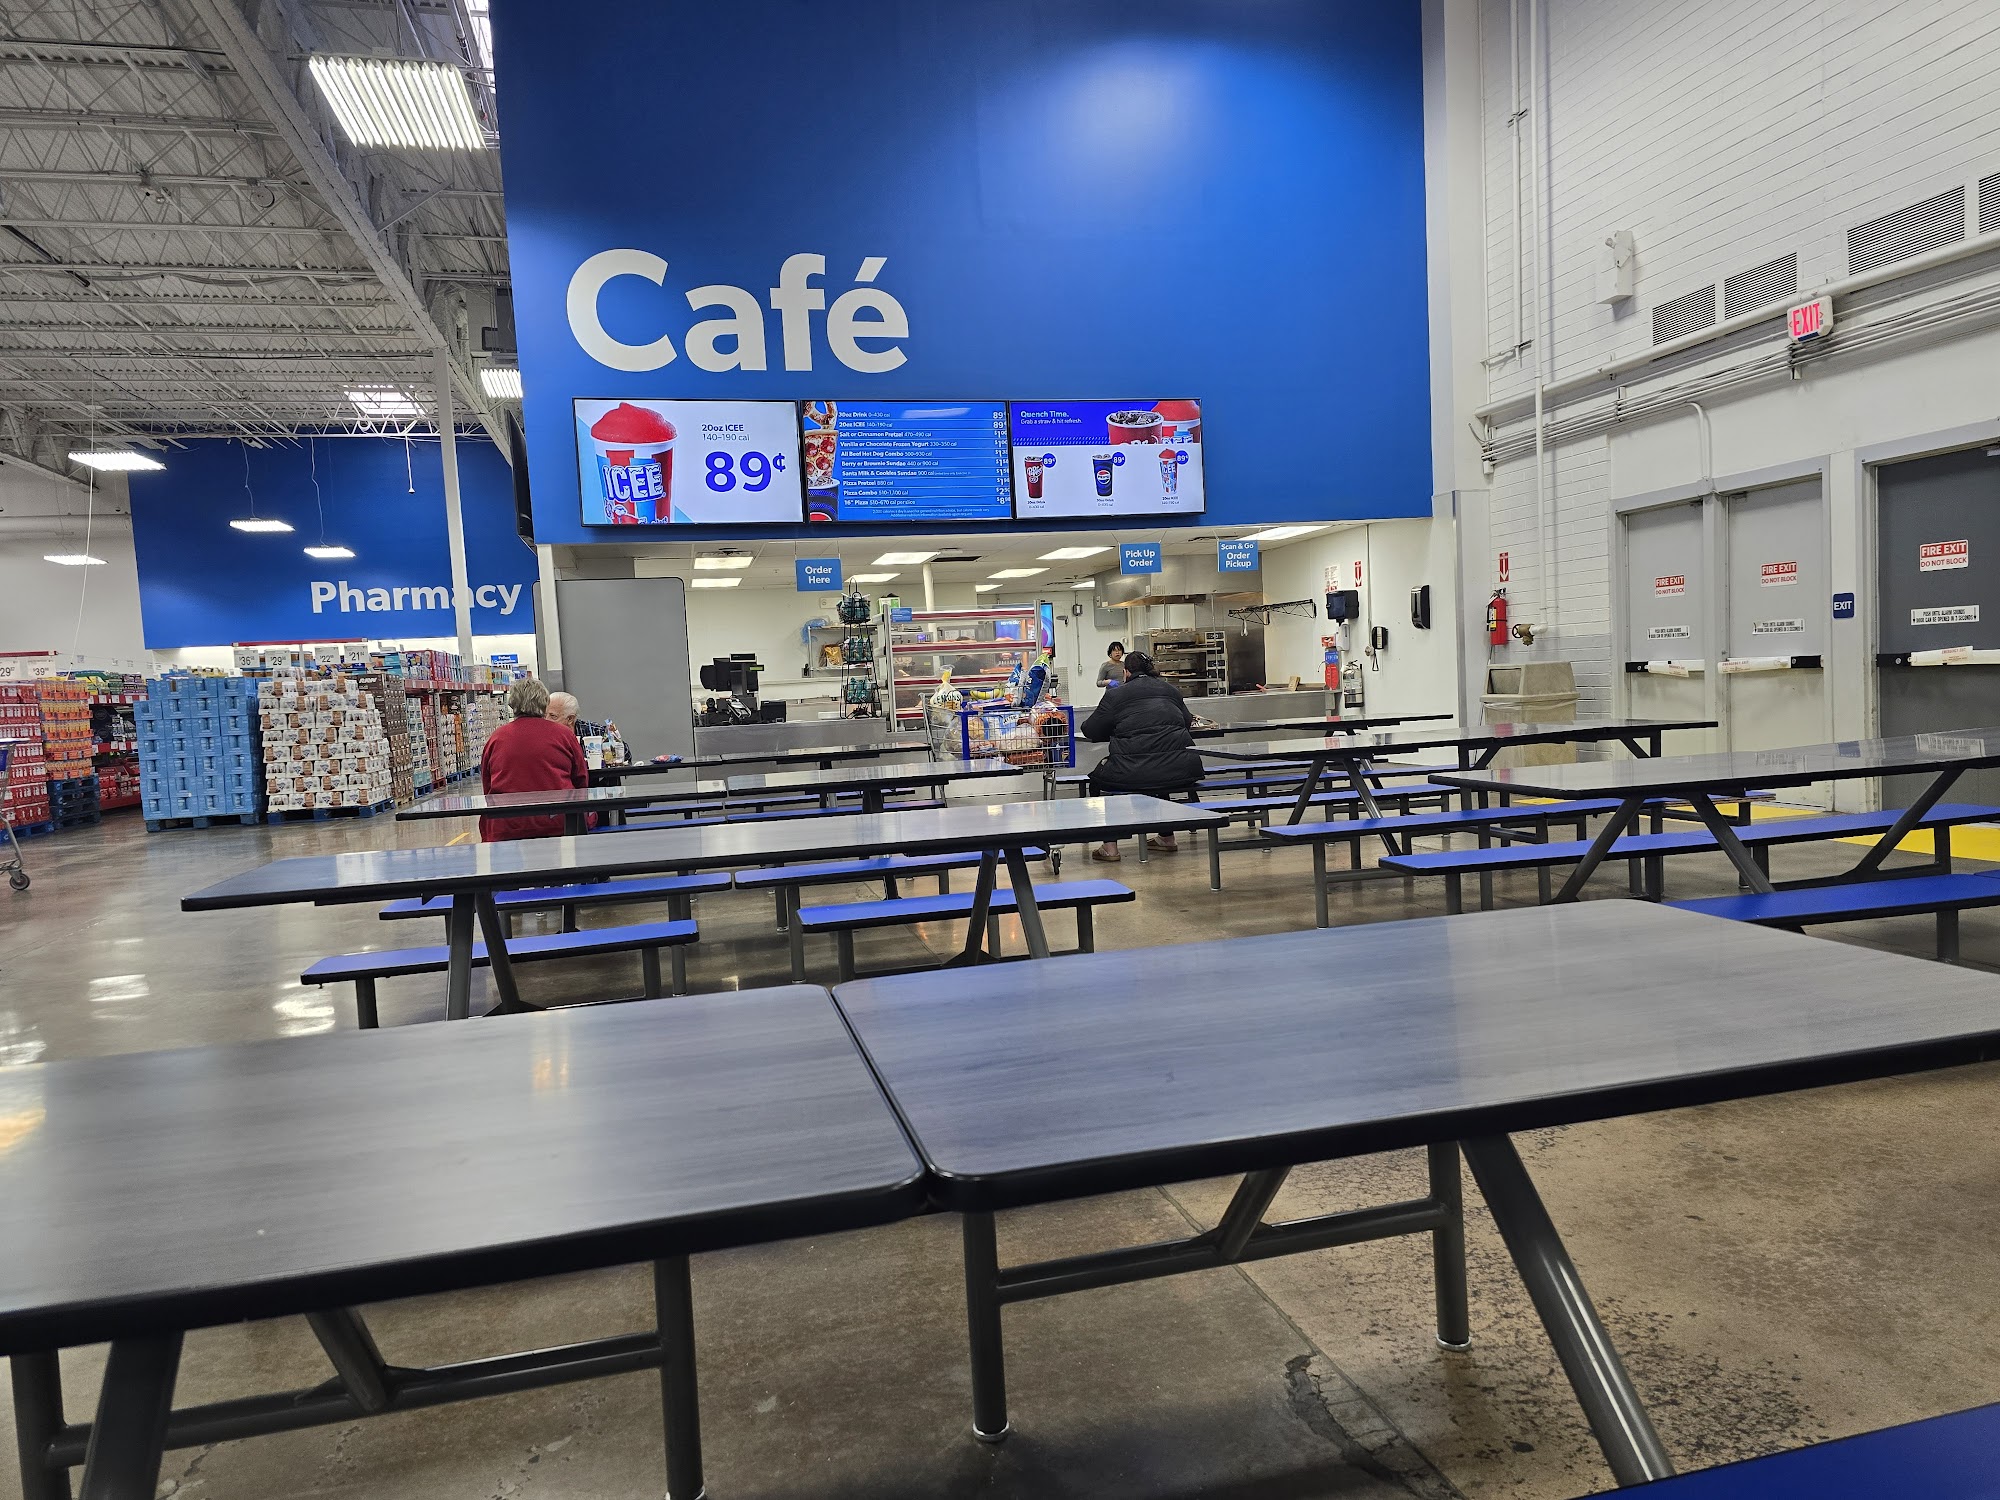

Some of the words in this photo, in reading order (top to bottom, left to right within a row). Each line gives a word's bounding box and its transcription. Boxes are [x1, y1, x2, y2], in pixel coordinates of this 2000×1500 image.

[566, 248, 909, 374] Café
[1793, 303, 1820, 336] EXIT
[701, 424, 724, 432] 20oz
[725, 424, 745, 432] ICEE
[738, 433, 750, 441] cal
[705, 451, 786, 492] 89¢
[602, 462, 665, 502] ICEE
[1126, 550, 1143, 558] Pick
[1143, 549, 1155, 559] Up
[1921, 545, 1942, 557] FIRE
[1944, 543, 1966, 555] EXIT
[1129, 559, 1153, 567] Order
[1225, 560, 1251, 568] Pickup
[1946, 557, 1967, 565] BLOCK
[805, 565, 833, 575] Order
[1762, 565, 1777, 575] FIRE
[1778, 562, 1797, 574] EXIT
[808, 575, 831, 584] Here
[1656, 578, 1669, 587] FIRE
[1670, 576, 1684, 586] EXIT
[1833, 601, 1852, 611] EXIT
